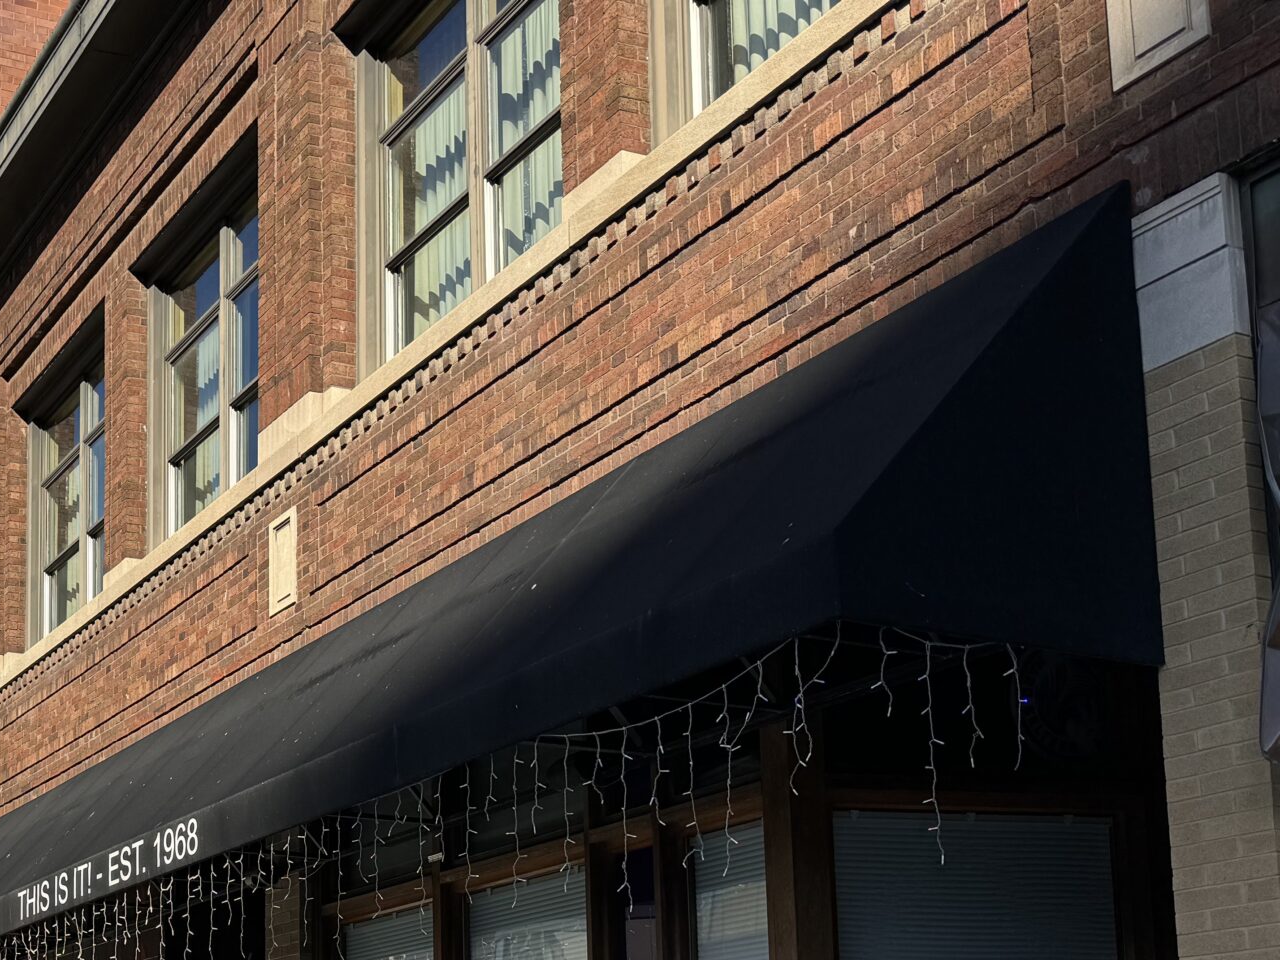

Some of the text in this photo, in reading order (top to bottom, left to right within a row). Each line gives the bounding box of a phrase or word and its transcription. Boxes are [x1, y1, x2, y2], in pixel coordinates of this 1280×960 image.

[18, 880, 49, 920] THIS
[54, 872, 69, 906] IS
[73, 862, 92, 899] IT!
[108, 839, 146, 886] EST.
[153, 817, 199, 868] 1968
